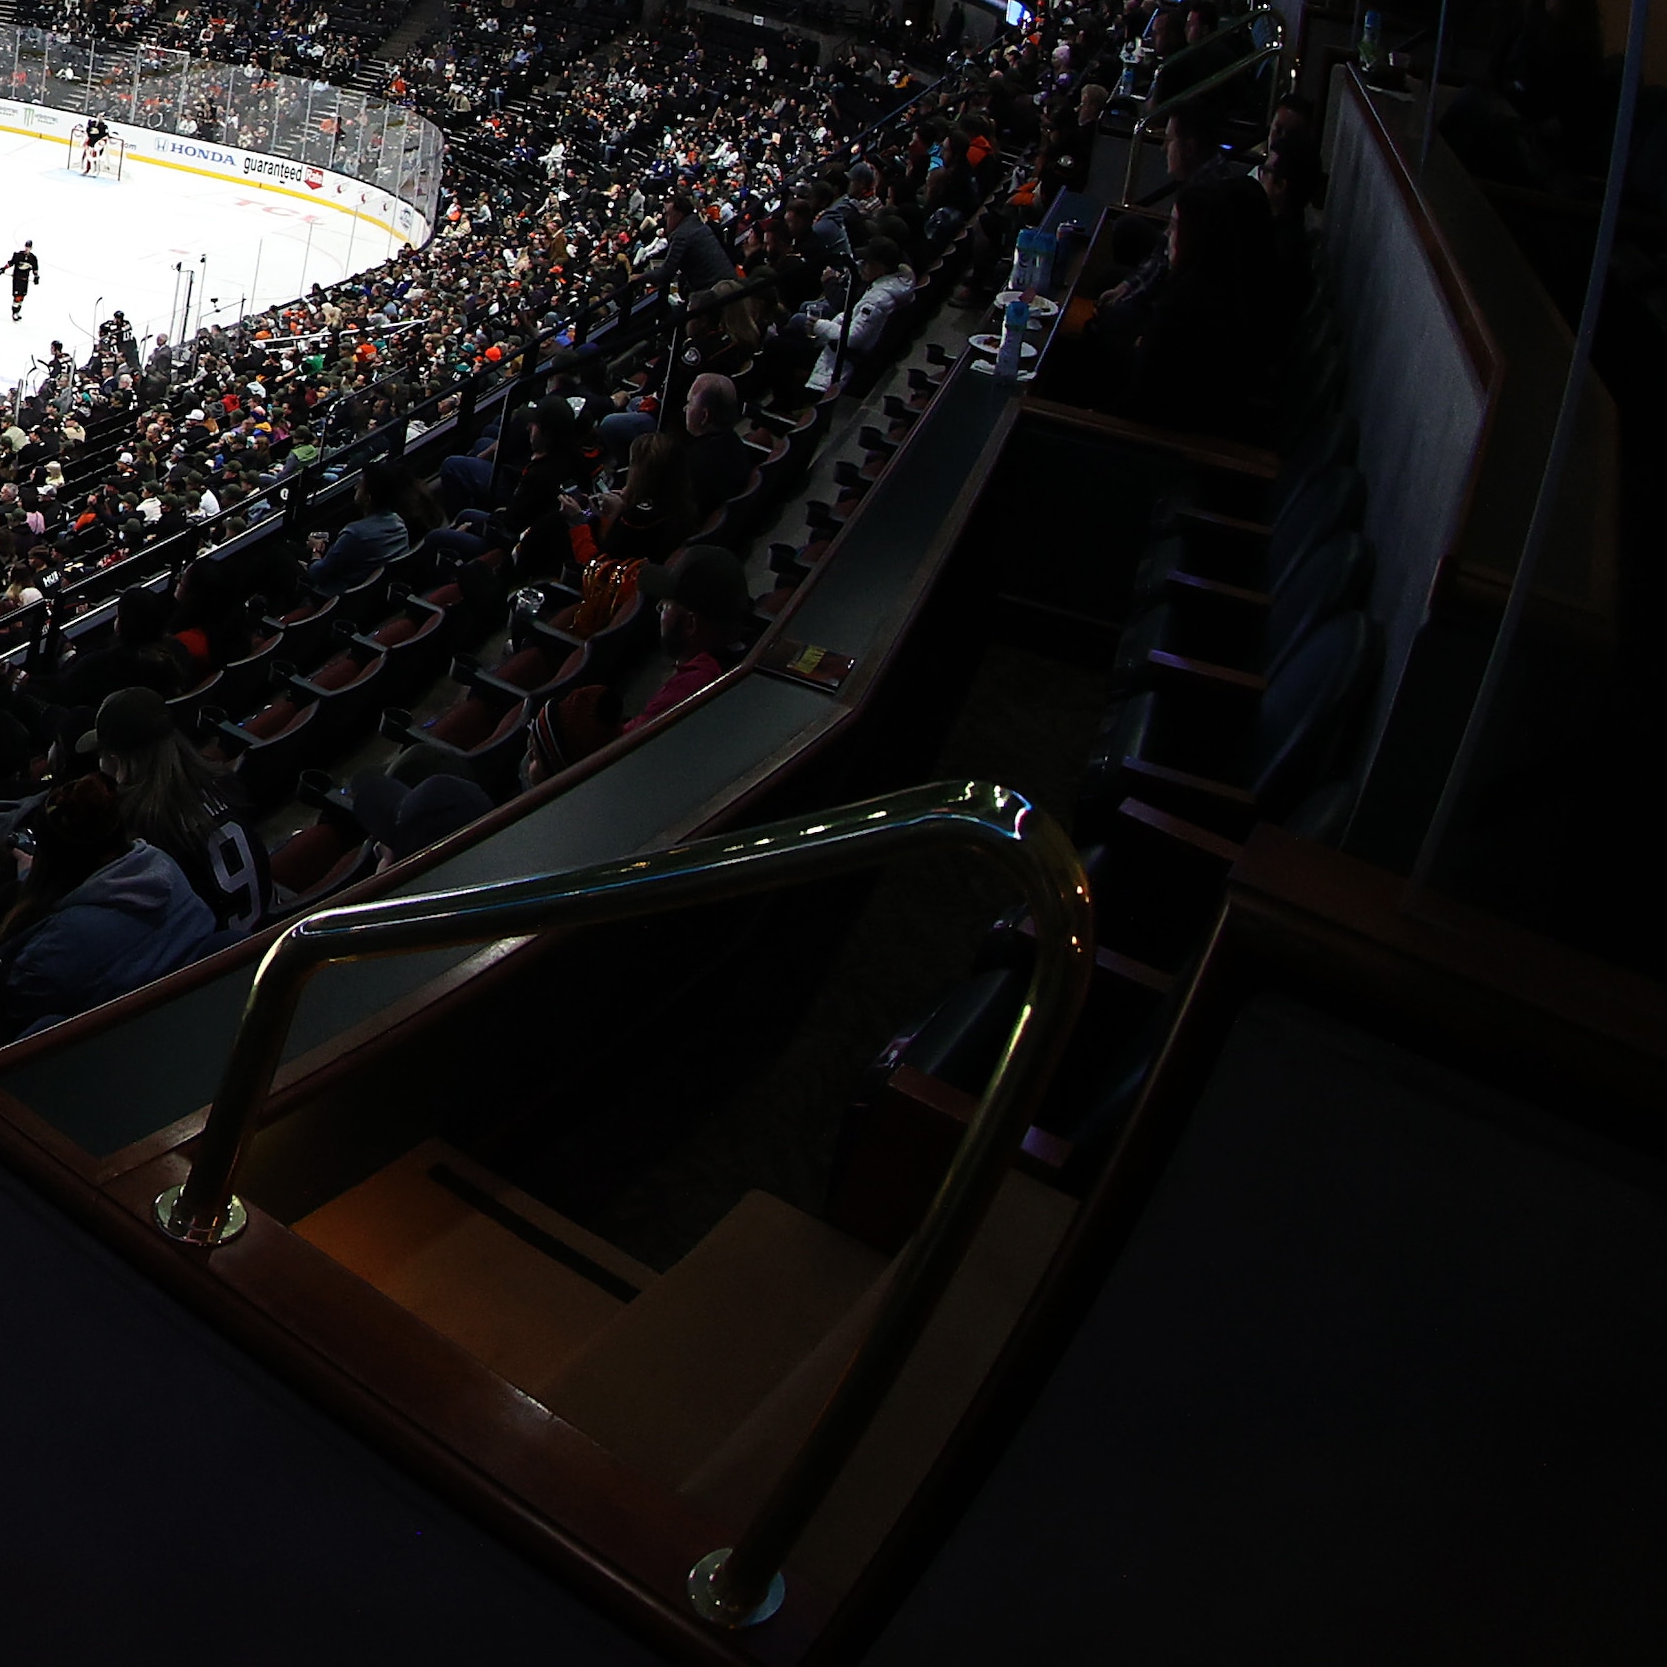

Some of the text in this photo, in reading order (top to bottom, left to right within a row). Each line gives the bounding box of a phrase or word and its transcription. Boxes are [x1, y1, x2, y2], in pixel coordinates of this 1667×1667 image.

[170, 143, 236, 166] HONDA
[244, 156, 323, 183] guaranteed Rate
